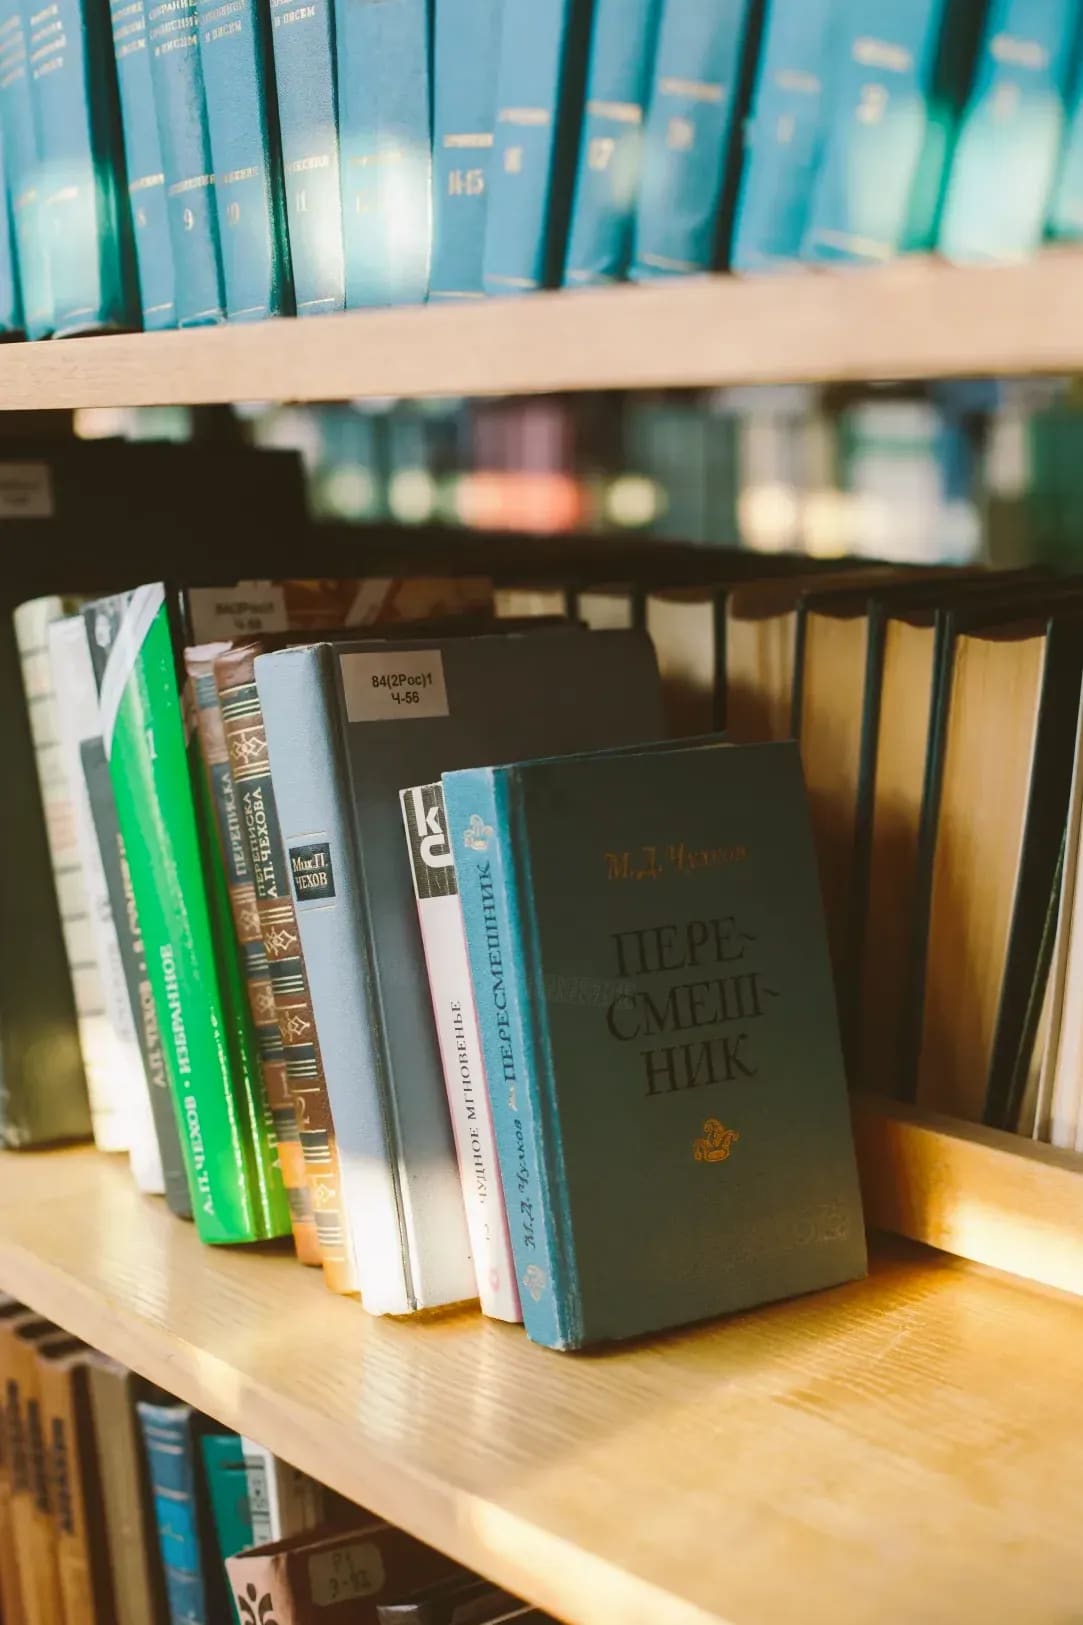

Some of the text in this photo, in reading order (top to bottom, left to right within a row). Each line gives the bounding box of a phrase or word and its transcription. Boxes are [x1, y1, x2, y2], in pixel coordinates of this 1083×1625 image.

[371, 672, 433, 690] 84(2Рос)1
[390, 690, 420, 704] Ч-56
[242, 791, 267, 897] ПЕРЕПИСКА
[295, 871, 328, 890] ЧЕХОВ
[159, 943, 191, 1075] ИЗБРАННОЕ
[477, 860, 516, 1082] ПЕРЕСМЕШНИК
[450, 1000, 477, 1121] МГНОВЕНЬЕ
[640, 1032, 760, 1097] НИК
